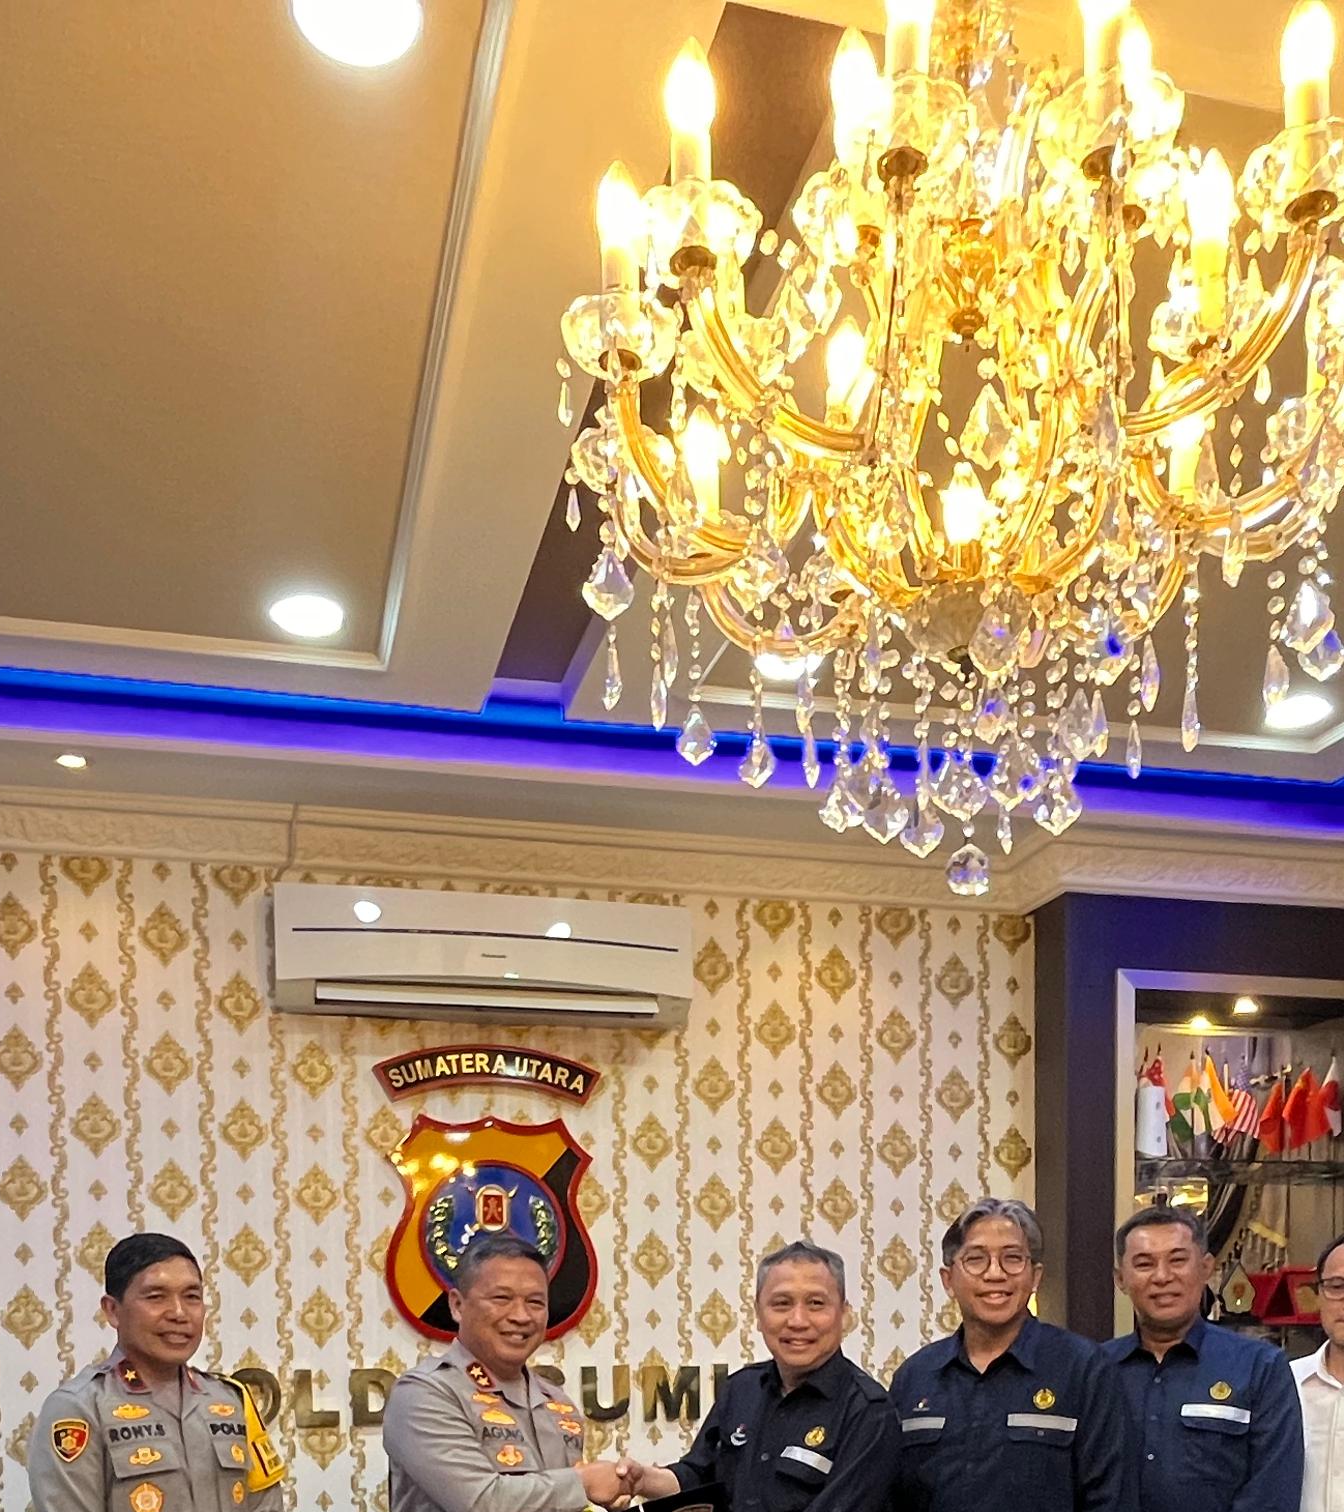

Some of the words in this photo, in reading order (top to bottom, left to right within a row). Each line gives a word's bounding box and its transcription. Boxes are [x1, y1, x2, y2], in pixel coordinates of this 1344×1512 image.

[388, 1053, 507, 1088] SUMATERA
[514, 1056, 584, 1094] UTARA
[230, 1367, 399, 1429] OLD
